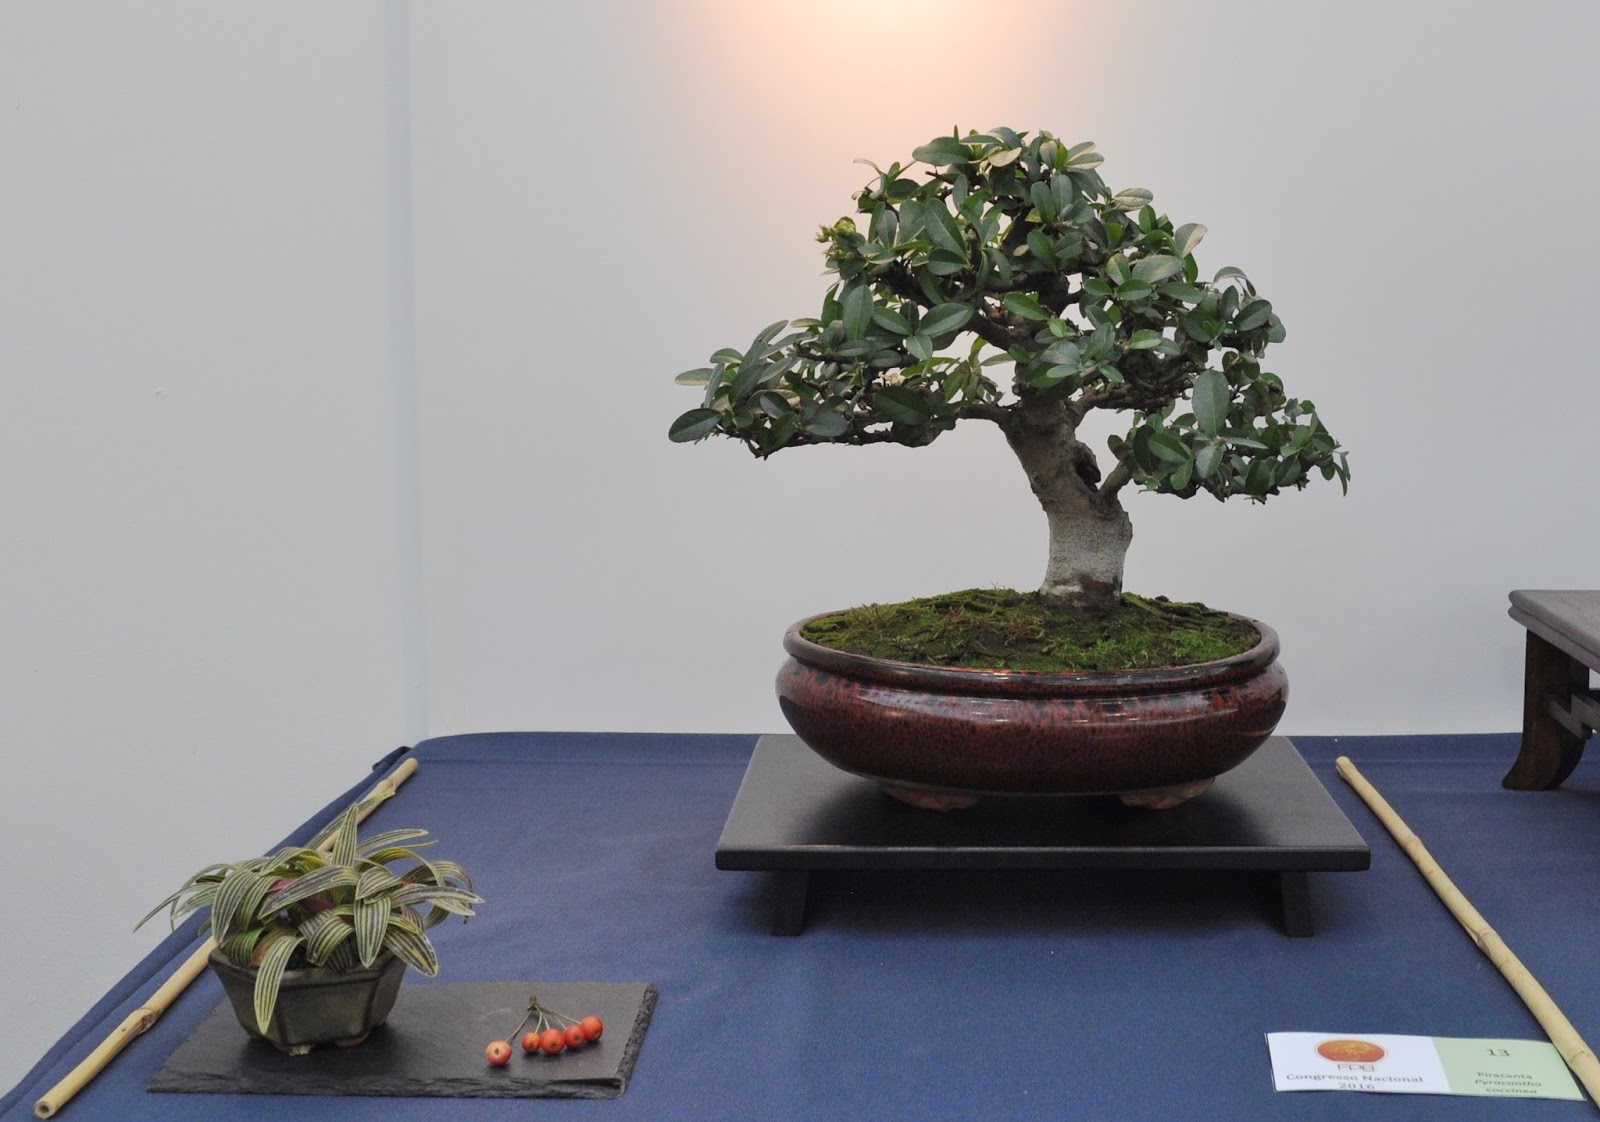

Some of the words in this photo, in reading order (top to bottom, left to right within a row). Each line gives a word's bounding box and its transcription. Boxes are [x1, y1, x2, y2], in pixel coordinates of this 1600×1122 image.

[1286, 1073, 1358, 1082] Congresso
[1363, 1074, 1423, 1082] Nacional
[1475, 1079, 1542, 1087] Pyracantha
